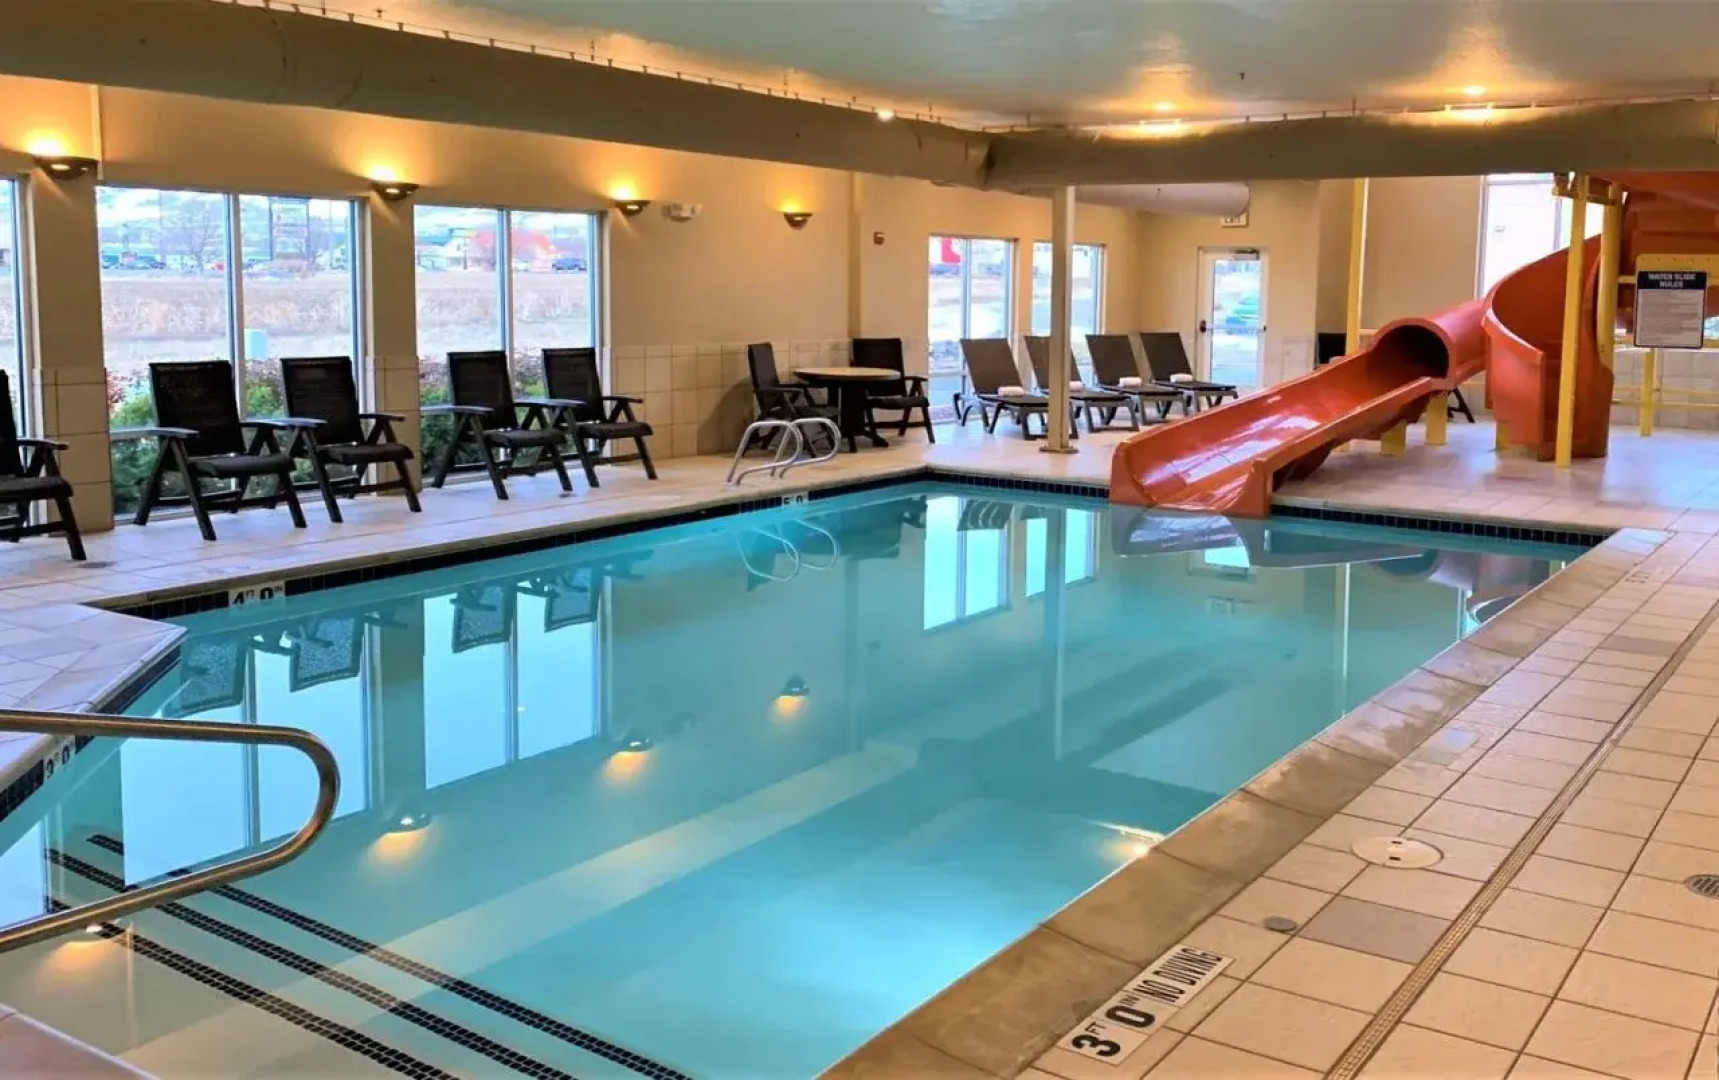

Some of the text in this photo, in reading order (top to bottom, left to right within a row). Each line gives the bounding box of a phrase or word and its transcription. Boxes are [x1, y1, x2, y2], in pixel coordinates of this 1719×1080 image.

[1659, 280, 1684, 288] RULES
[1152, 946, 1223, 987] DIVING
[1132, 979, 1186, 1003] NO
[1105, 1005, 1156, 1028] 0
[1071, 1033, 1121, 1057] 3
